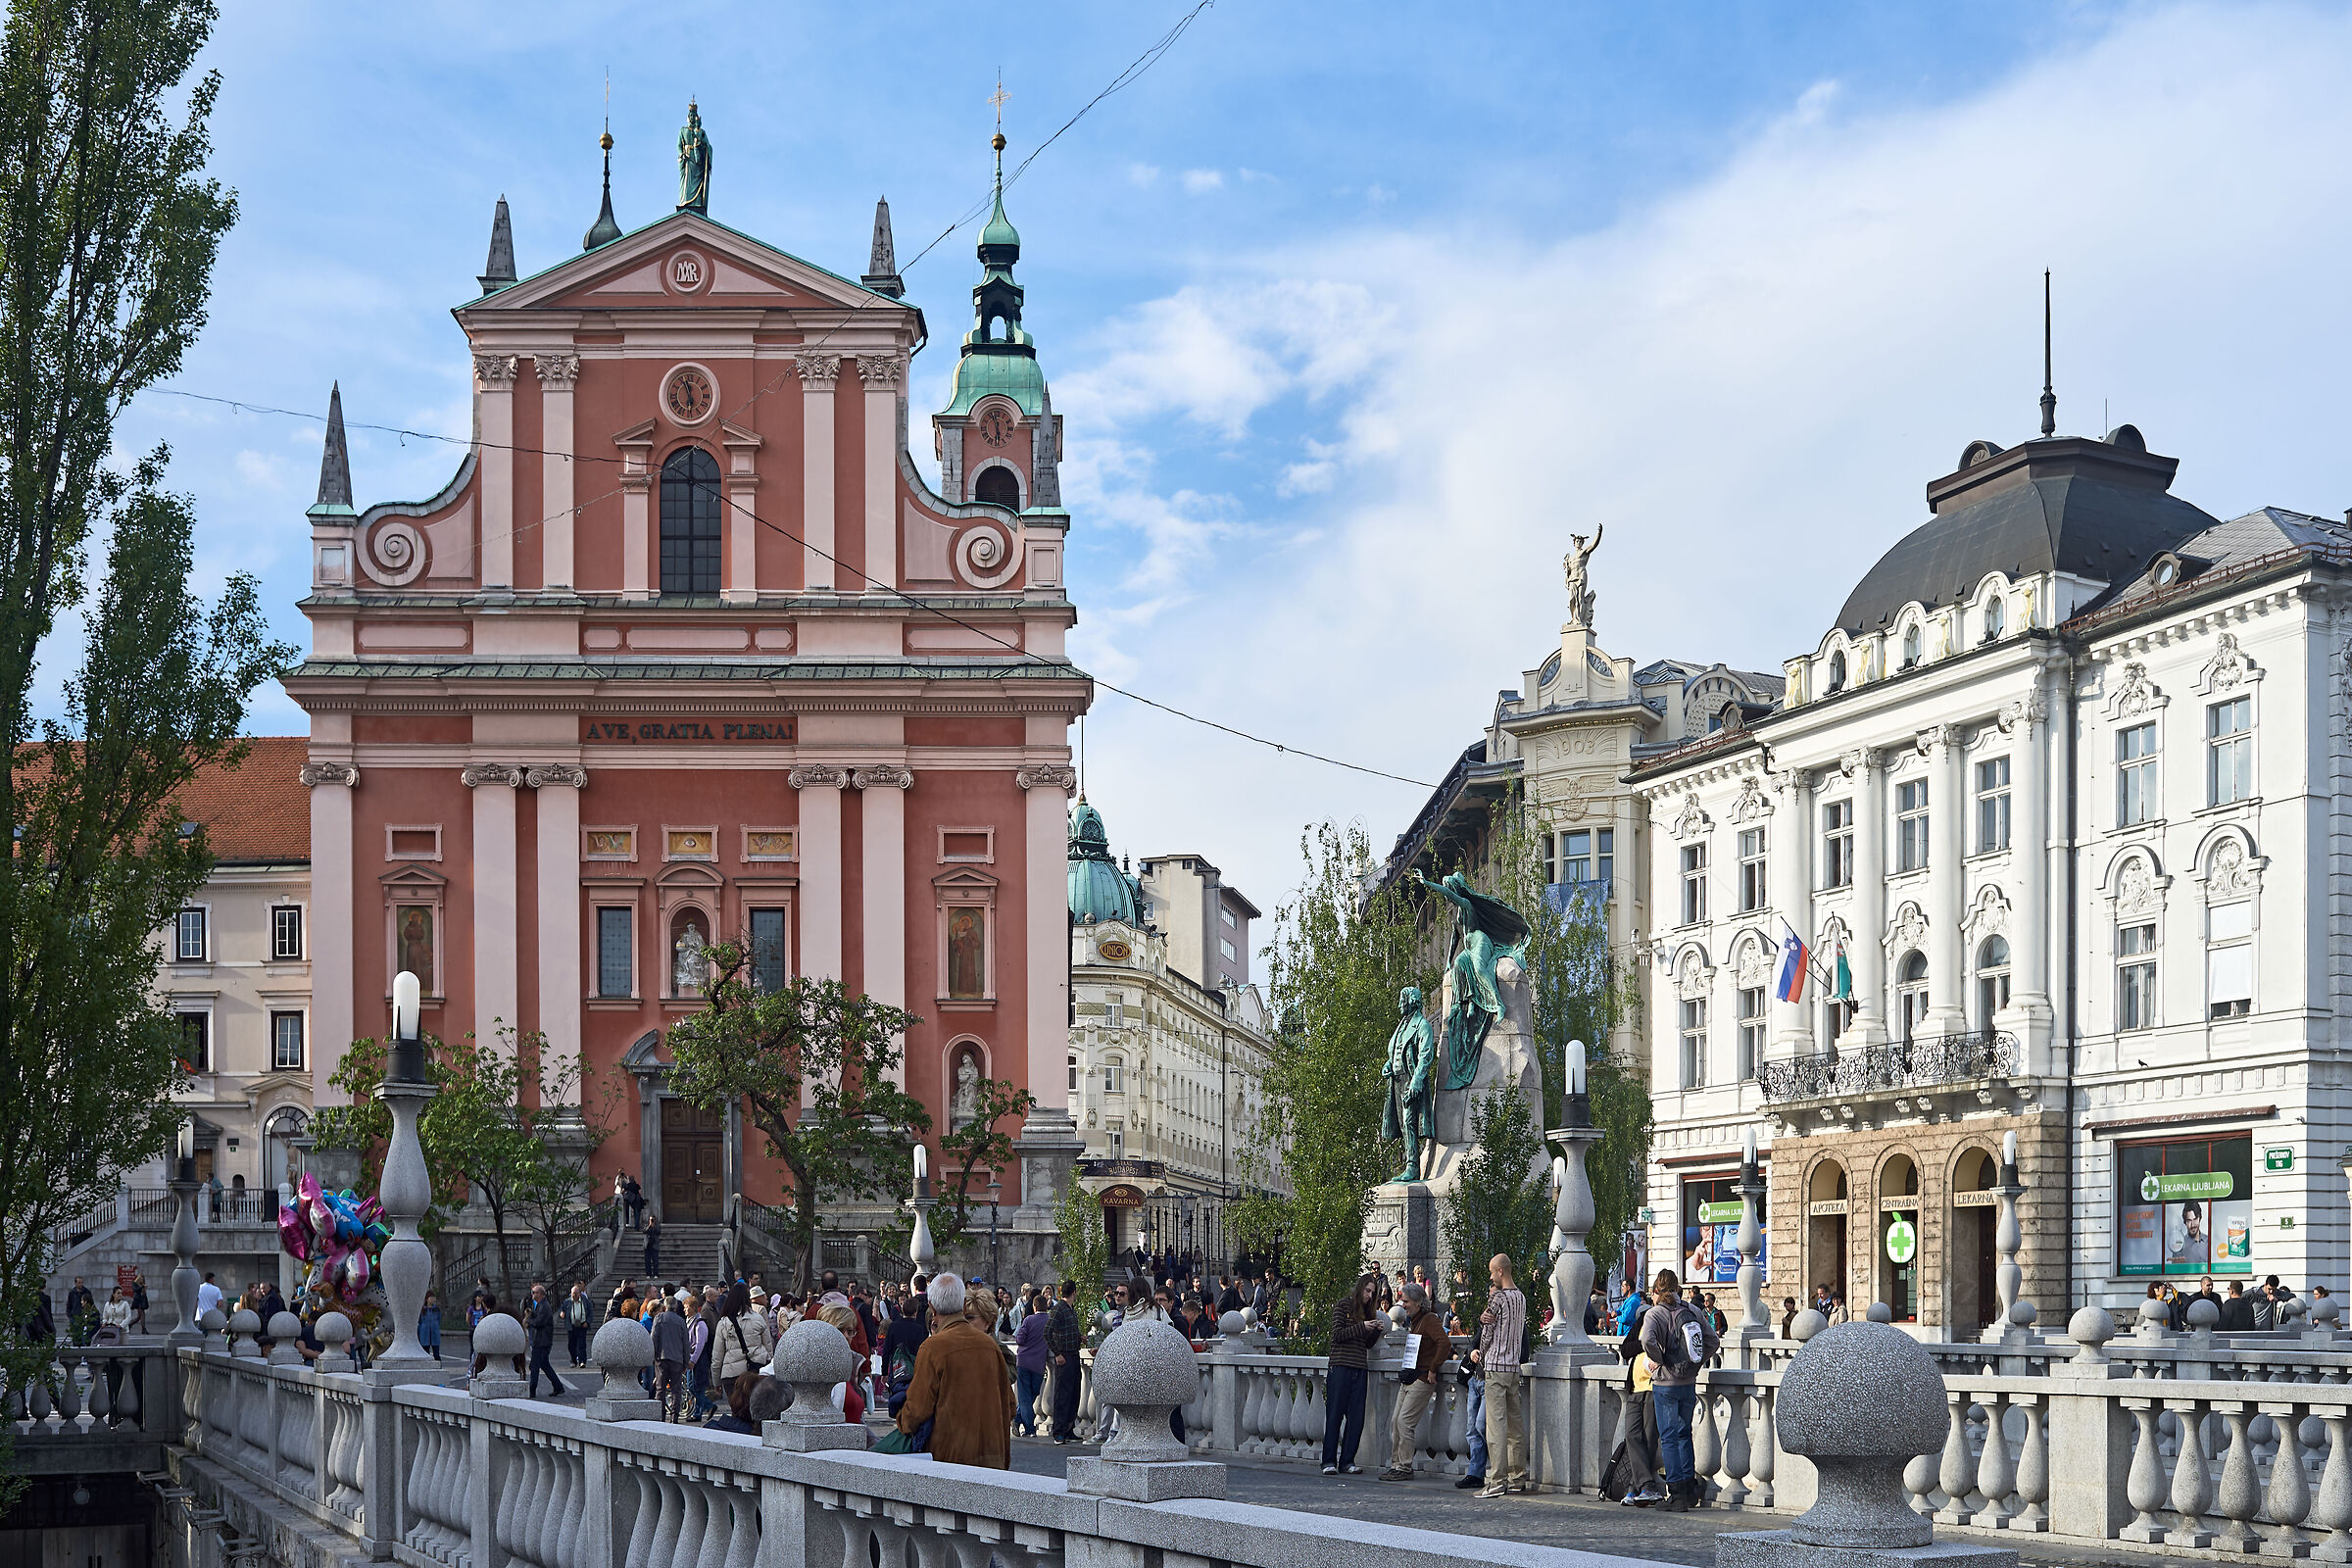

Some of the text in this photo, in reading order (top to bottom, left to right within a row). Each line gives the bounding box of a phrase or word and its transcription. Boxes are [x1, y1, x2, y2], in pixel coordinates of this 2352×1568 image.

[586, 722, 793, 745] AVE, GRATIA PLENA!
[1553, 740, 1595, 760] 1903
[1103, 944, 1129, 957] UNION
[1108, 1165, 1139, 1176] BUDAPEST
[2161, 1181, 2230, 1194] LEKARNA LJUBLJANA
[1103, 1197, 1140, 1206] KAVARNA
[1957, 1193, 1995, 1204] LEKARNA
[1813, 1201, 1845, 1213] APOTEKA
